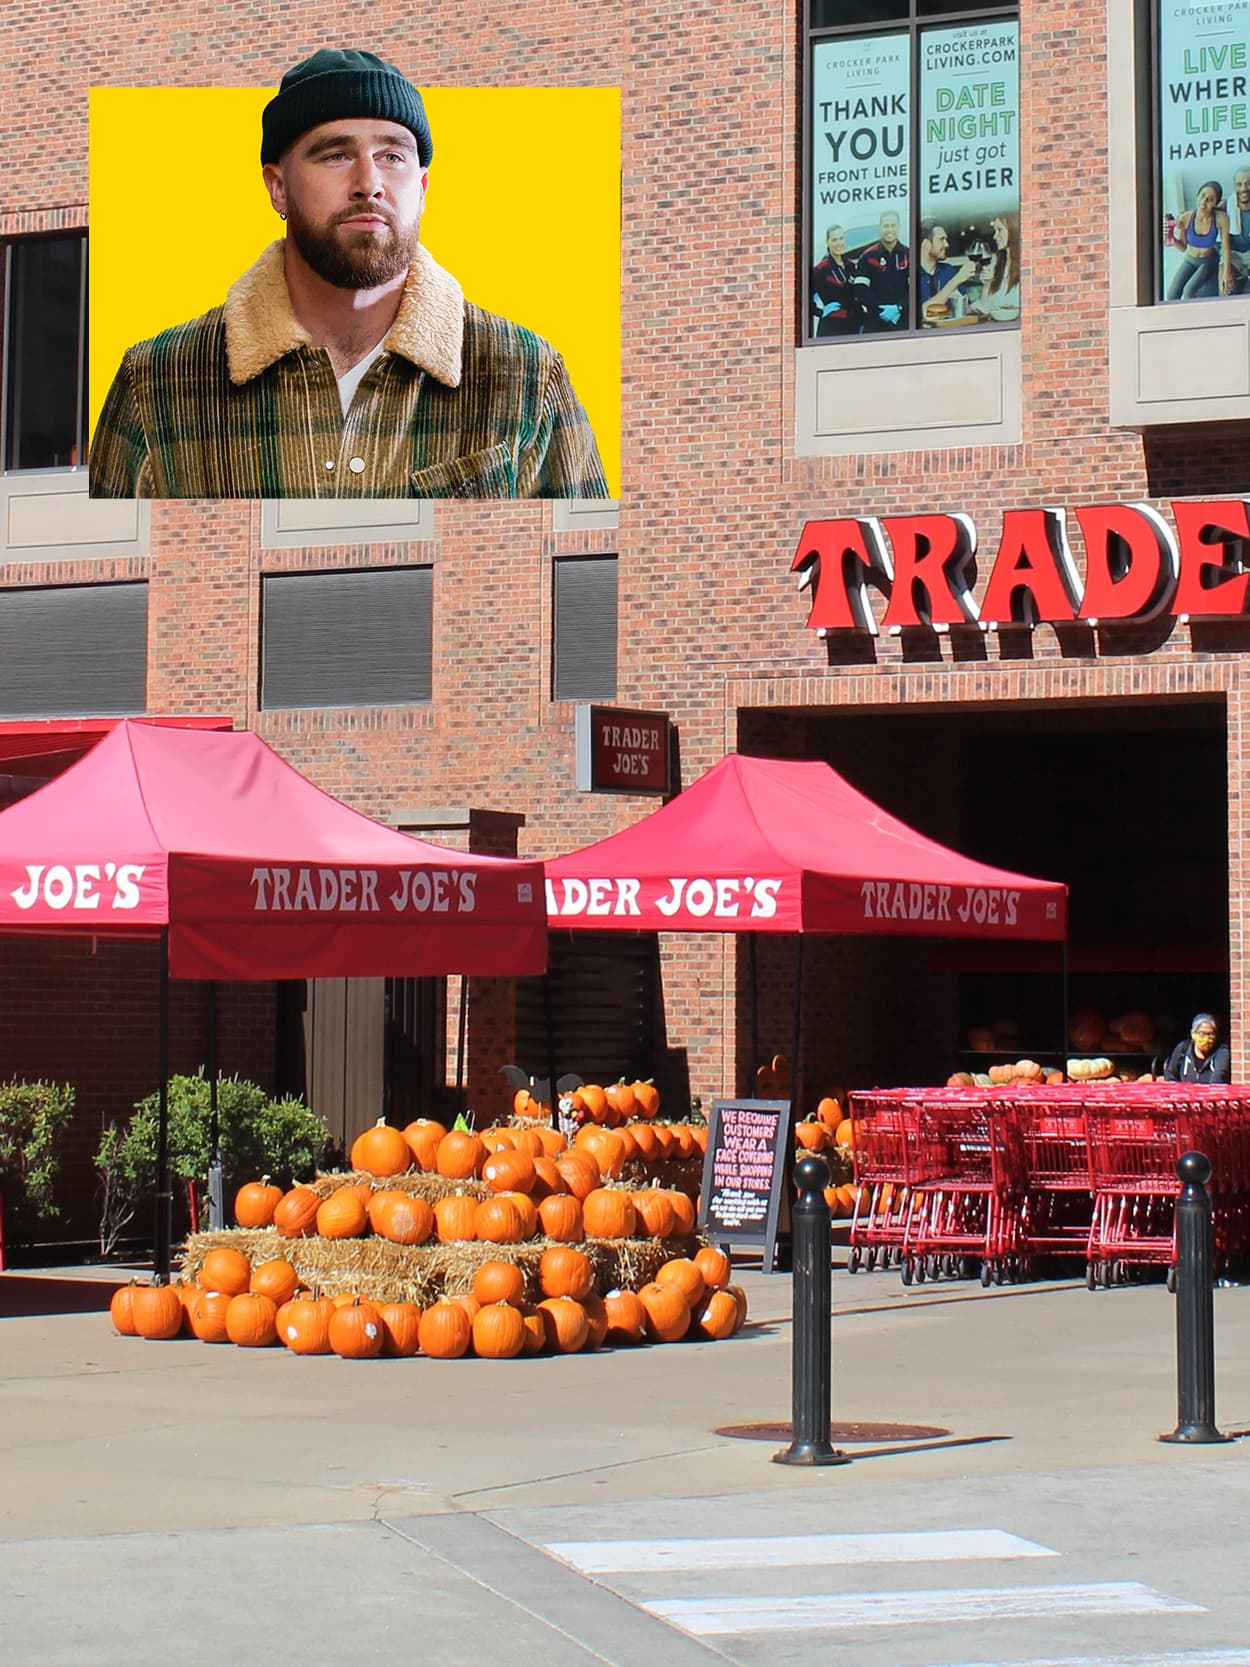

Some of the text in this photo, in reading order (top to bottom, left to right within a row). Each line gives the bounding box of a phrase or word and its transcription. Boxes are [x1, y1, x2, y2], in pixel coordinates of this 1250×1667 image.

[1196, 14, 1233, 26] LIVING
[926, 36, 1015, 56] CROCKERPARK
[1184, 43, 1248, 75] LIVE
[846, 66, 880, 79] LIVING
[926, 50, 1016, 71] LIVING.COM
[819, 93, 907, 122] THANK
[936, 82, 1006, 112] DATE
[926, 110, 1016, 143] NIGHT
[1185, 104, 1248, 135] LIFE
[825, 125, 905, 163] YOU
[936, 143, 1007, 169] just got
[818, 164, 908, 185] FRONT LINE
[928, 168, 1014, 194] EASIER
[820, 183, 908, 205] WORKERS
[602, 724, 660, 751] TRADER
[612, 753, 650, 777] JOE'S
[10, 862, 146, 910] JOE'S
[250, 867, 380, 912] TRADER
[389, 869, 478, 914] JOE'S
[655, 877, 783, 918] JOE'S
[860, 881, 953, 921] TRADER
[957, 887, 1021, 926] JOE'S
[721, 1110, 779, 1127] WE REQUIRE
[715, 1148, 737, 1163] FACE
[723, 1136, 767, 1151] WEAR A
[714, 1175, 725, 1188] IN
[725, 1176, 742, 1188] OUR
